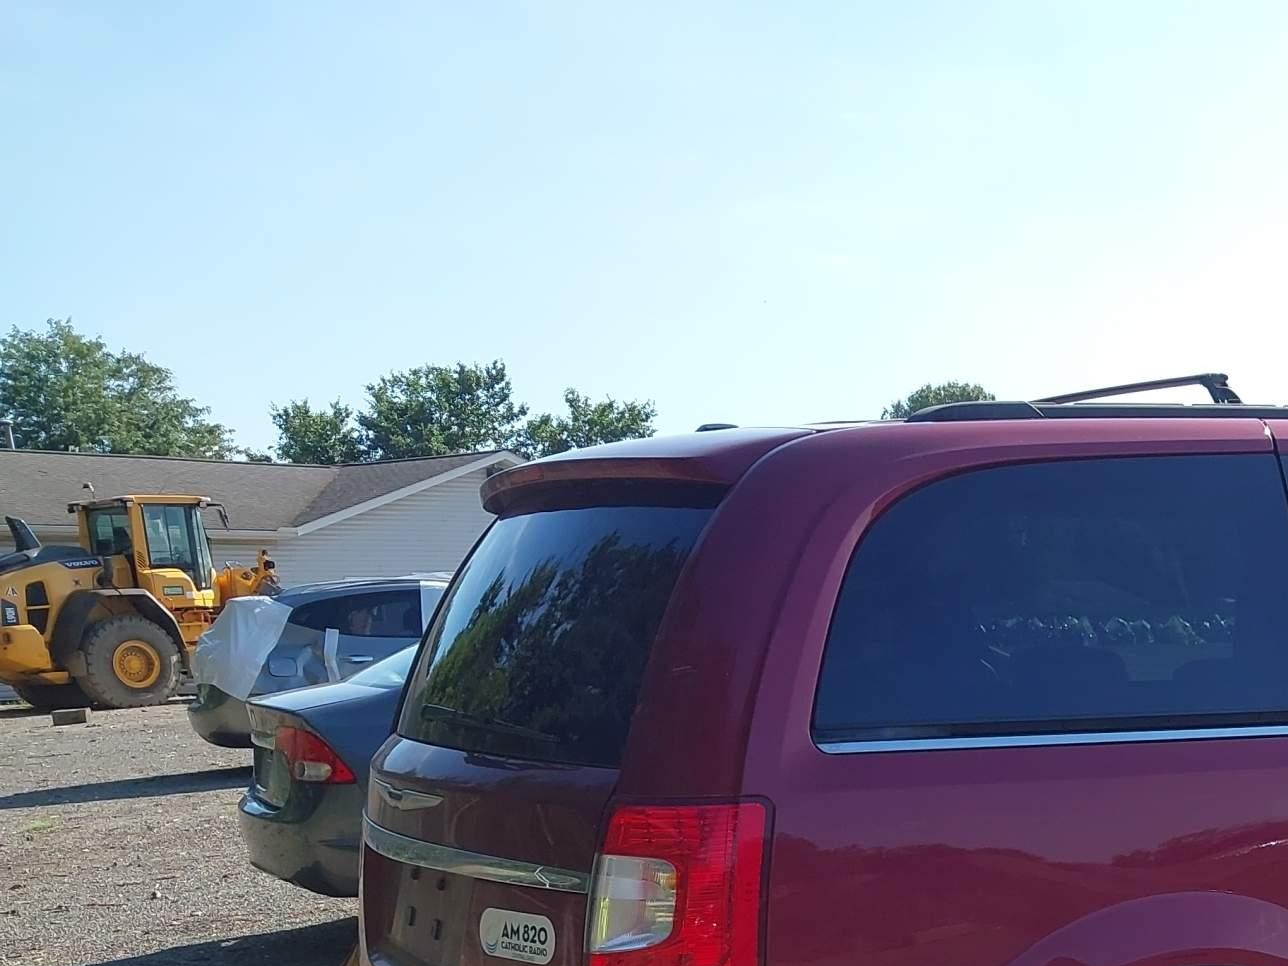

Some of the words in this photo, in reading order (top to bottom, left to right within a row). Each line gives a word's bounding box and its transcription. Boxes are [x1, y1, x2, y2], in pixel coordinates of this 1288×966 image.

[502, 920, 520, 941] AM
[522, 924, 548, 945] 820
[501, 941, 528, 953] CATHOLIC
[529, 946, 548, 957] RADIO
